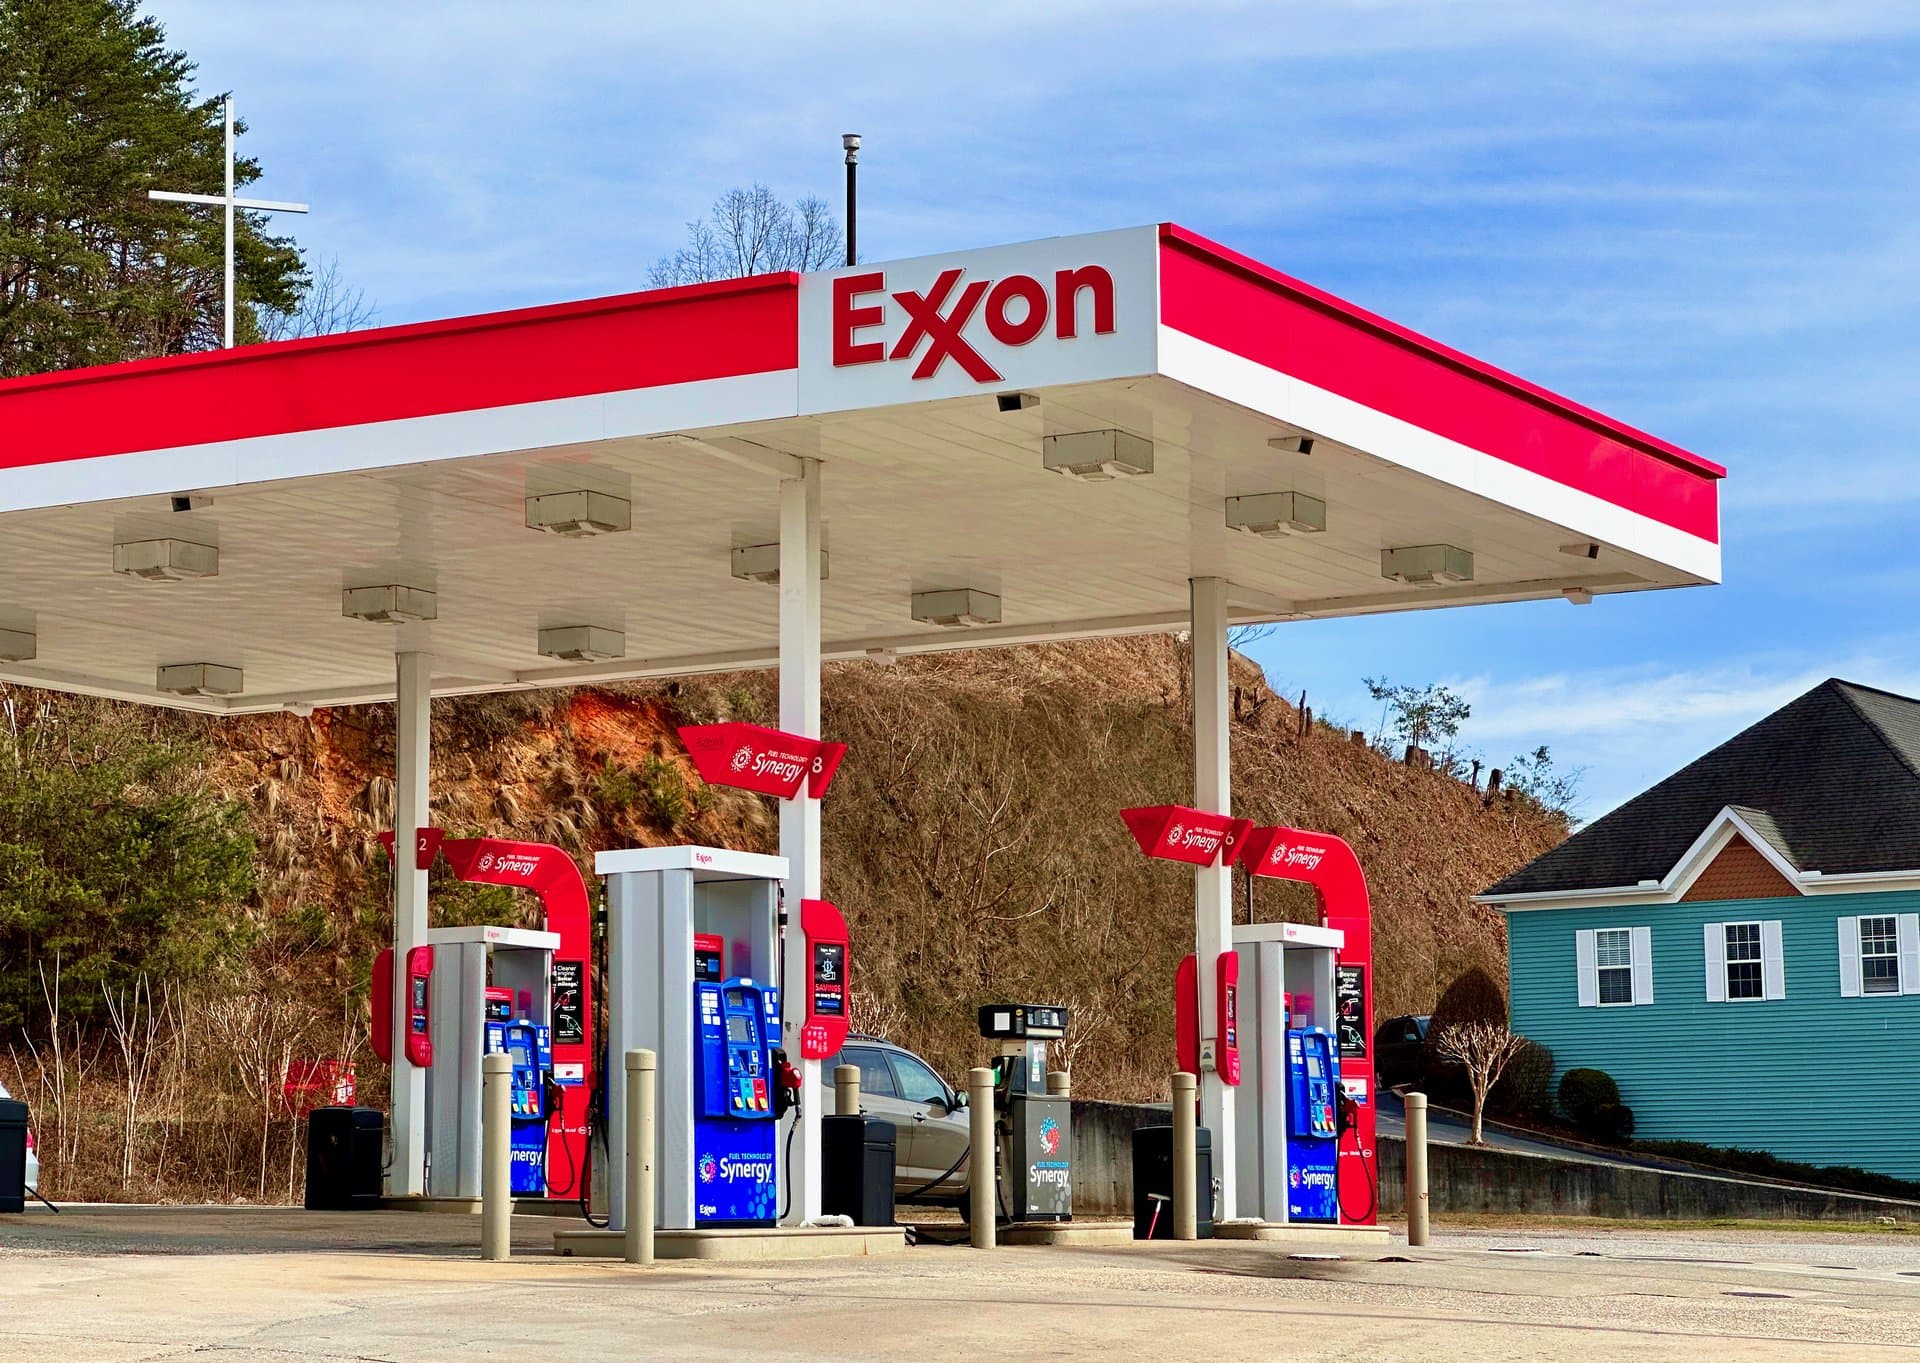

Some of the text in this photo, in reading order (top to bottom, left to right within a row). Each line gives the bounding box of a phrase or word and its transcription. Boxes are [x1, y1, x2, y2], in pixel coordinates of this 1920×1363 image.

[832, 264, 1117, 384] Exxon
[767, 750, 808, 764] FUEL TECHNOLOGY
[811, 756, 823, 774] 8
[751, 753, 804, 783] Synergy
[419, 838, 428, 851] 2
[1182, 829, 1221, 854] Synergy
[1225, 831, 1235, 846] 6
[494, 856, 538, 876] Synergy
[696, 852, 713, 864] Exxon
[1284, 847, 1323, 871] Synergy
[815, 983, 842, 993] SAVINGS
[771, 991, 778, 1004] 8
[510, 1150, 543, 1166] ynergy
[728, 1152, 772, 1160] FUEL TECHNOLOGY
[719, 1157, 773, 1184] Synergy
[1030, 1164, 1070, 1188] Synergy
[1302, 1168, 1335, 1190] Synergy
[699, 1203, 717, 1216] Exxon
